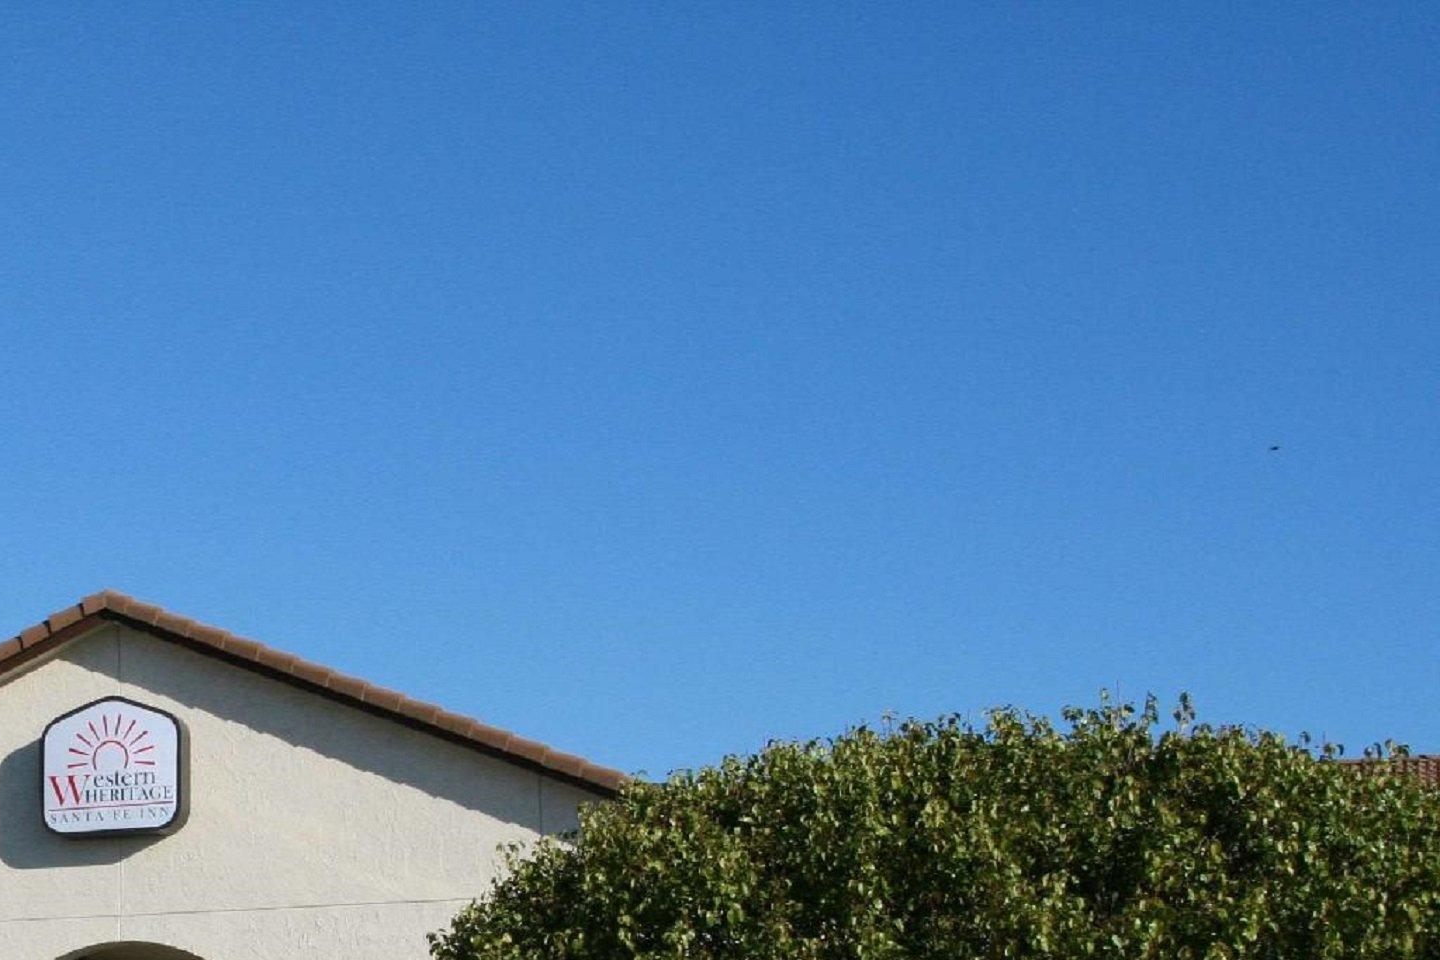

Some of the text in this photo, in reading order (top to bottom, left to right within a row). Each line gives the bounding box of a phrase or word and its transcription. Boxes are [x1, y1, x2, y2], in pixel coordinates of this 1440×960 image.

[48, 771, 156, 806] Western
[85, 785, 174, 803] HERITAGE
[50, 806, 170, 824] SANTA FE INN
